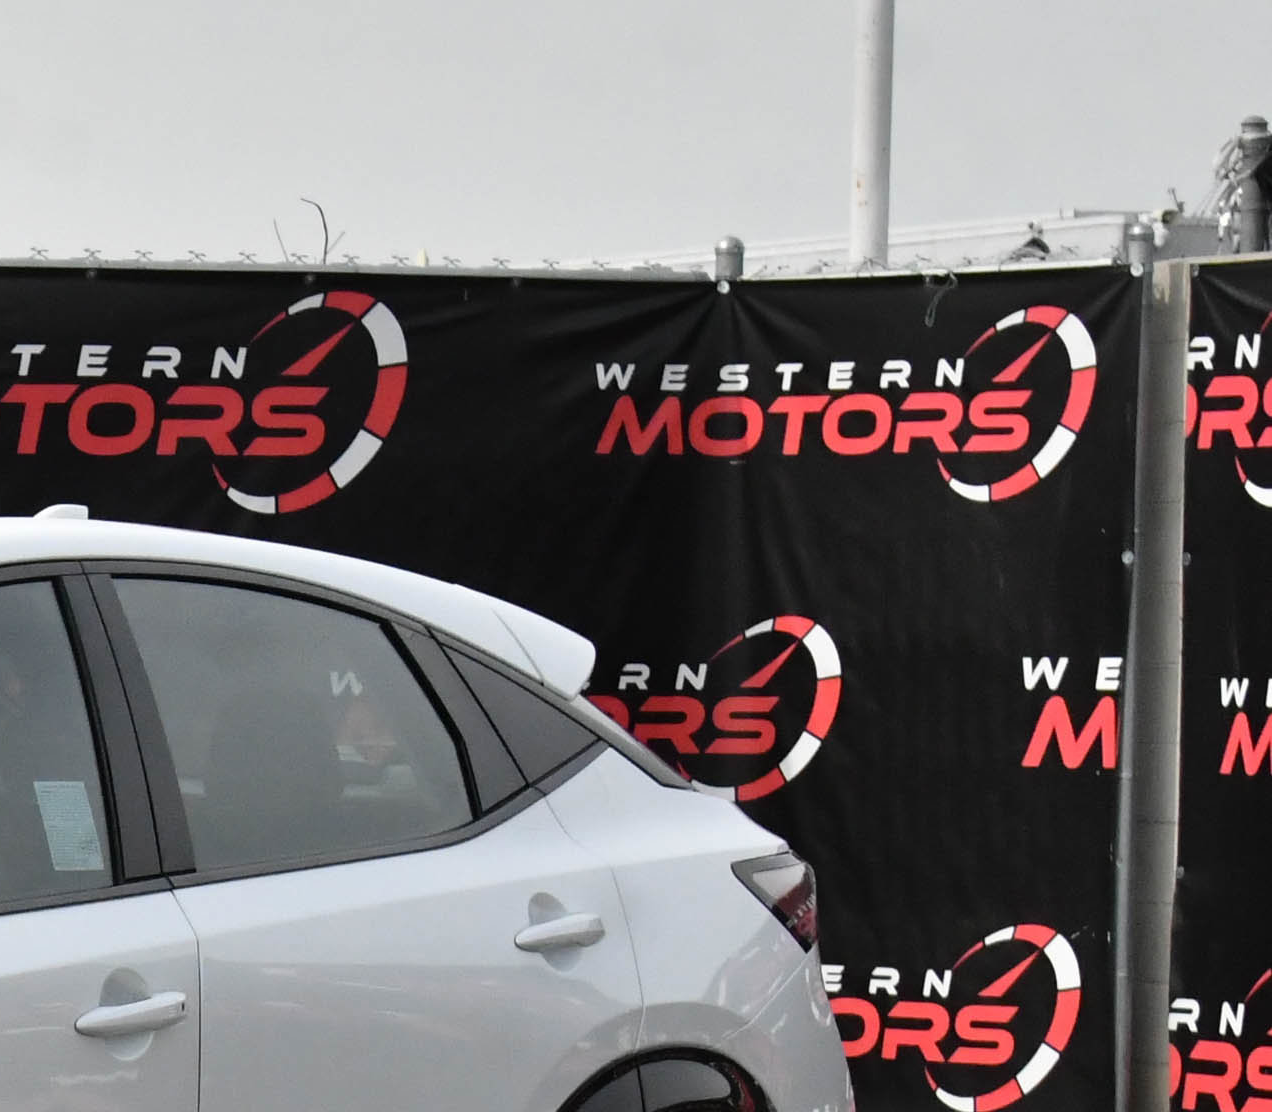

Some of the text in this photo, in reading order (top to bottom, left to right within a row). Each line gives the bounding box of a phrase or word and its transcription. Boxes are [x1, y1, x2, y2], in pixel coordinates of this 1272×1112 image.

[595, 358, 965, 391] WESTERN
[595, 389, 1034, 457] MOTORS
[582, 663, 708, 691] RN
